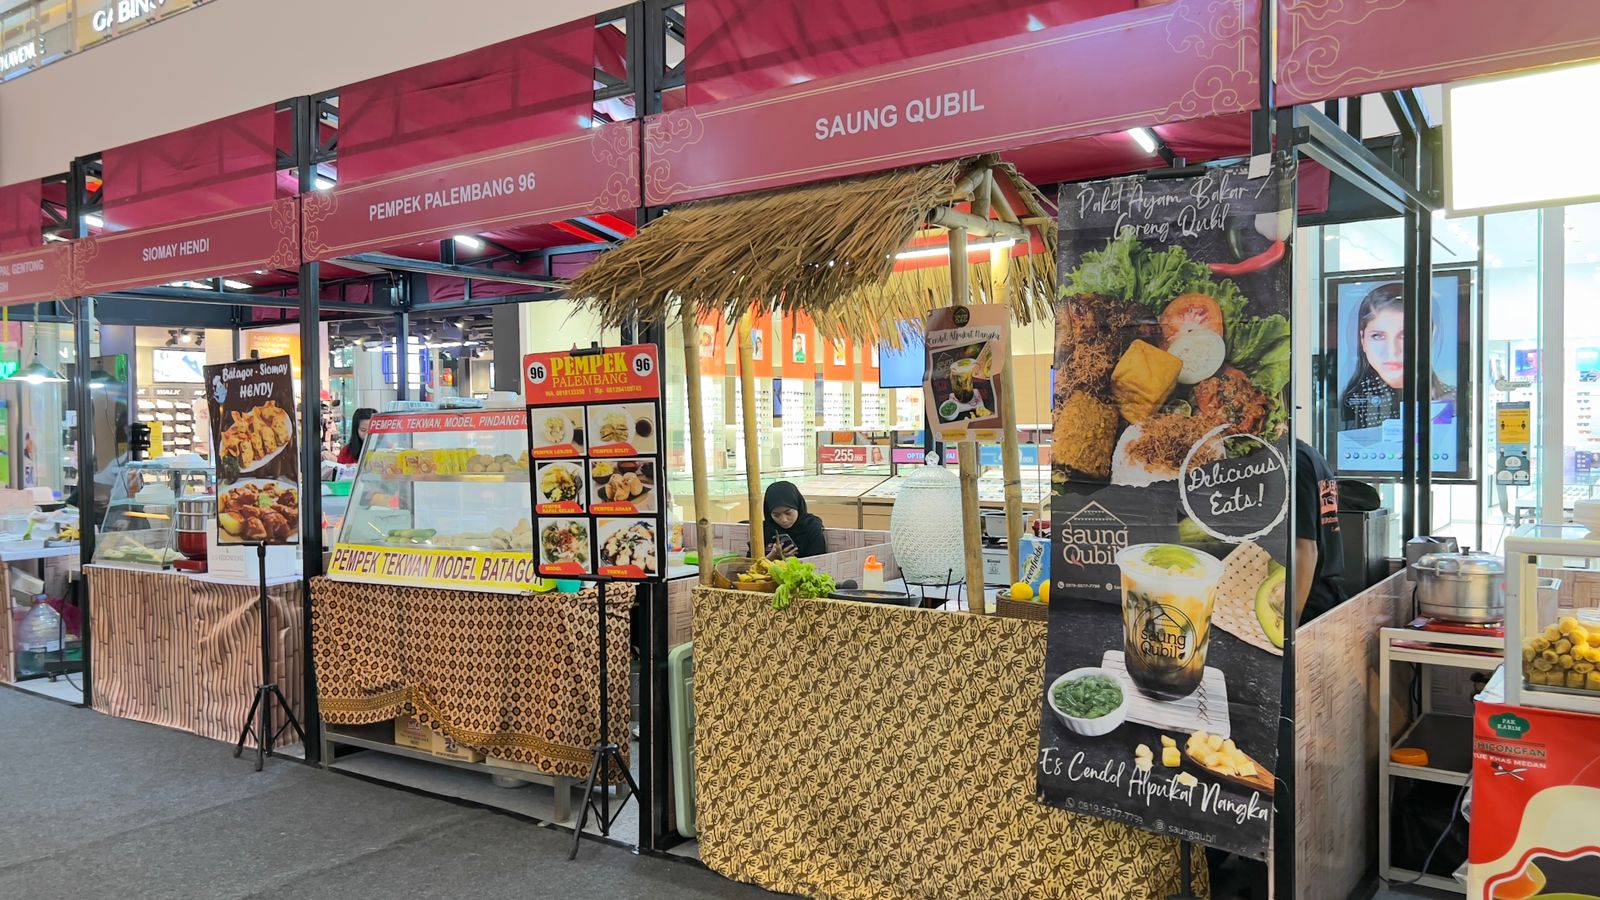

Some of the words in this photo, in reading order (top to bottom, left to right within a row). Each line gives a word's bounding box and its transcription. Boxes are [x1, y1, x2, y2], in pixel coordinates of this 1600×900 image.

[815, 104, 898, 141] SAUNG
[905, 88, 985, 123] QUBIL
[369, 194, 422, 221] PEMPEK
[425, 176, 515, 210] PALEMBANG
[518, 172, 536, 192] 96
[1077, 185, 1124, 219] Paket
[1127, 184, 1182, 219] Ayam
[1189, 176, 1249, 210] Bakar
[1113, 211, 1170, 242] Goreng
[1177, 203, 1231, 238] Qubil
[142, 243, 178, 262] SIOMAY
[179, 238, 210, 256] HENDI
[11, 259, 45, 274] GENTONG
[259, 362, 288, 377] Siomay
[530, 366, 544, 380] 96
[549, 351, 629, 378] PEMPEK
[635, 358, 650, 372] 96
[239, 382, 274, 399] HENDY
[552, 372, 628, 388] PALEMBANG
[478, 415, 519, 427] PINDANG
[1187, 457, 1281, 492] Delicious
[1209, 482, 1265, 516] Eats!
[1061, 521, 1129, 550] saung
[331, 548, 381, 573] PEMPEK
[381, 552, 432, 578] TEKWAN
[432, 555, 477, 580] MODEL
[1021, 545, 1043, 584] reenfields
[1063, 543, 1118, 572] Qubil
[1141, 627, 1187, 648] saung
[1489, 754, 1512, 764] KHAS
[1513, 760, 1547, 769] MEDAN
[1039, 748, 1064, 776] Es
[1068, 751, 1126, 788] Cendol
[1128, 767, 1196, 807] Alpukat
[1199, 783, 1269, 825] Nangka
